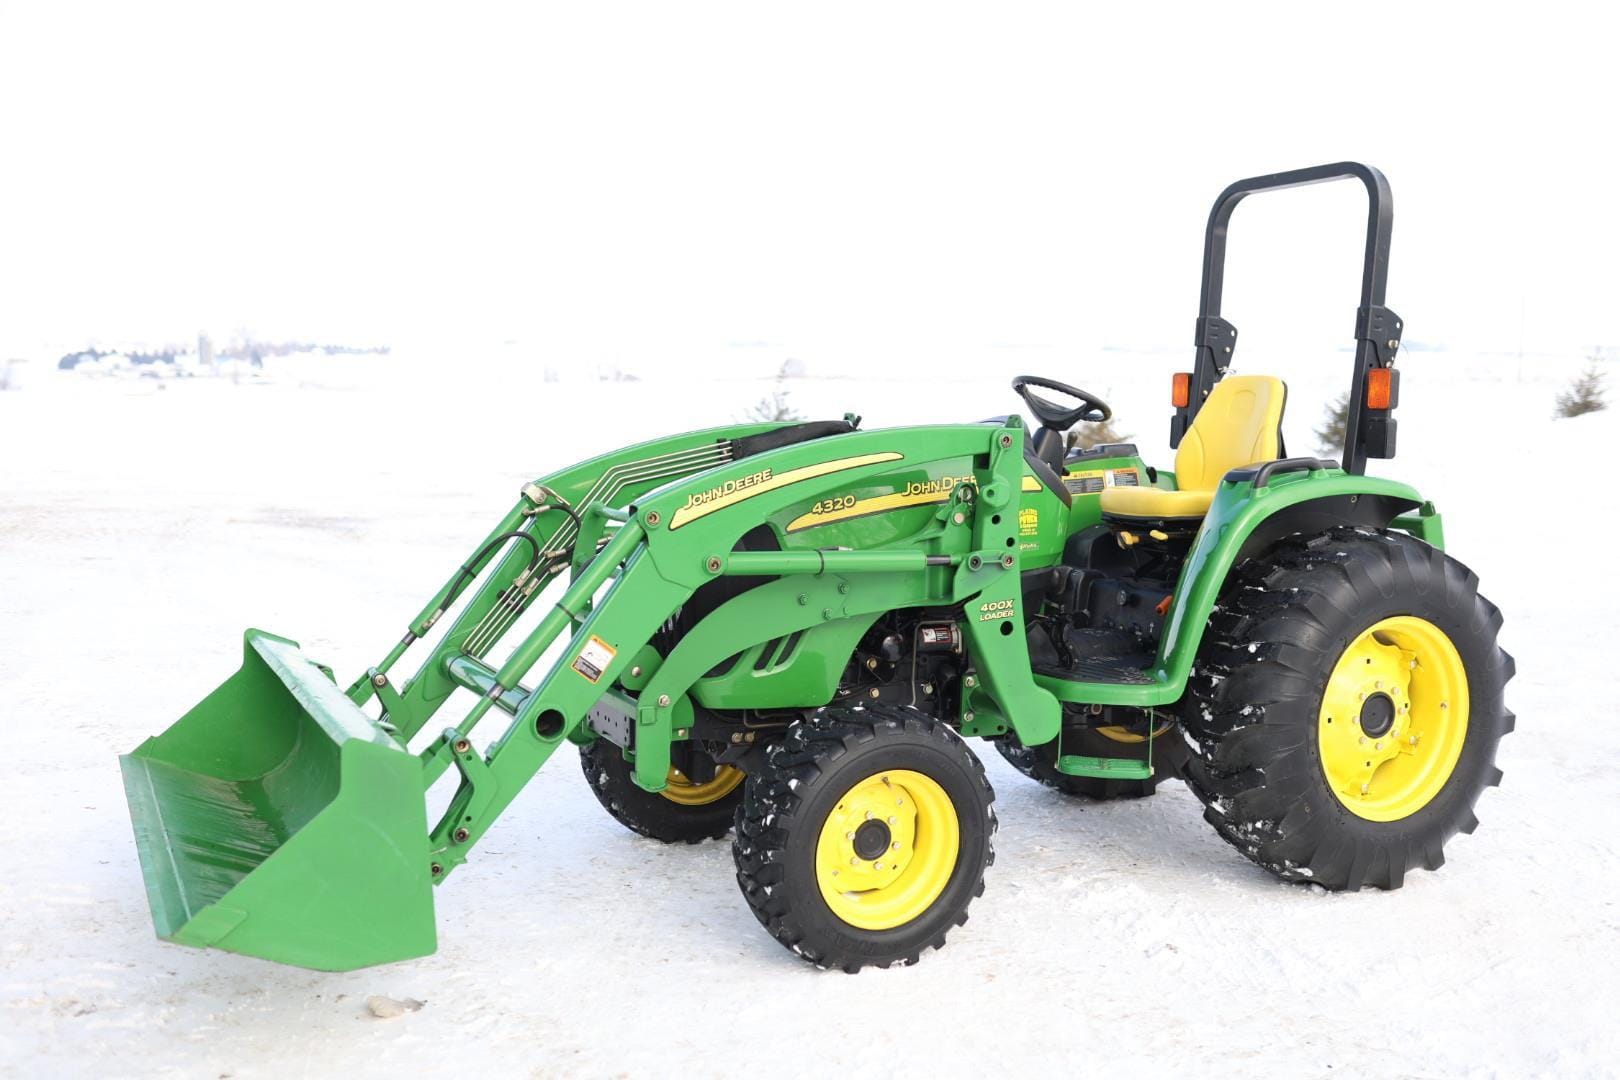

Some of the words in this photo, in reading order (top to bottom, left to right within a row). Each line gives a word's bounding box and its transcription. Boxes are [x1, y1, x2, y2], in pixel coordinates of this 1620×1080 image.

[683, 486, 723, 510] JOHN
[724, 468, 773, 496] DEERE
[902, 479, 940, 497] JOHN
[942, 475, 979, 491] DEER
[812, 495, 855, 515] 4320
[980, 599, 1014, 612] 400X
[980, 610, 1014, 621] LOADER
